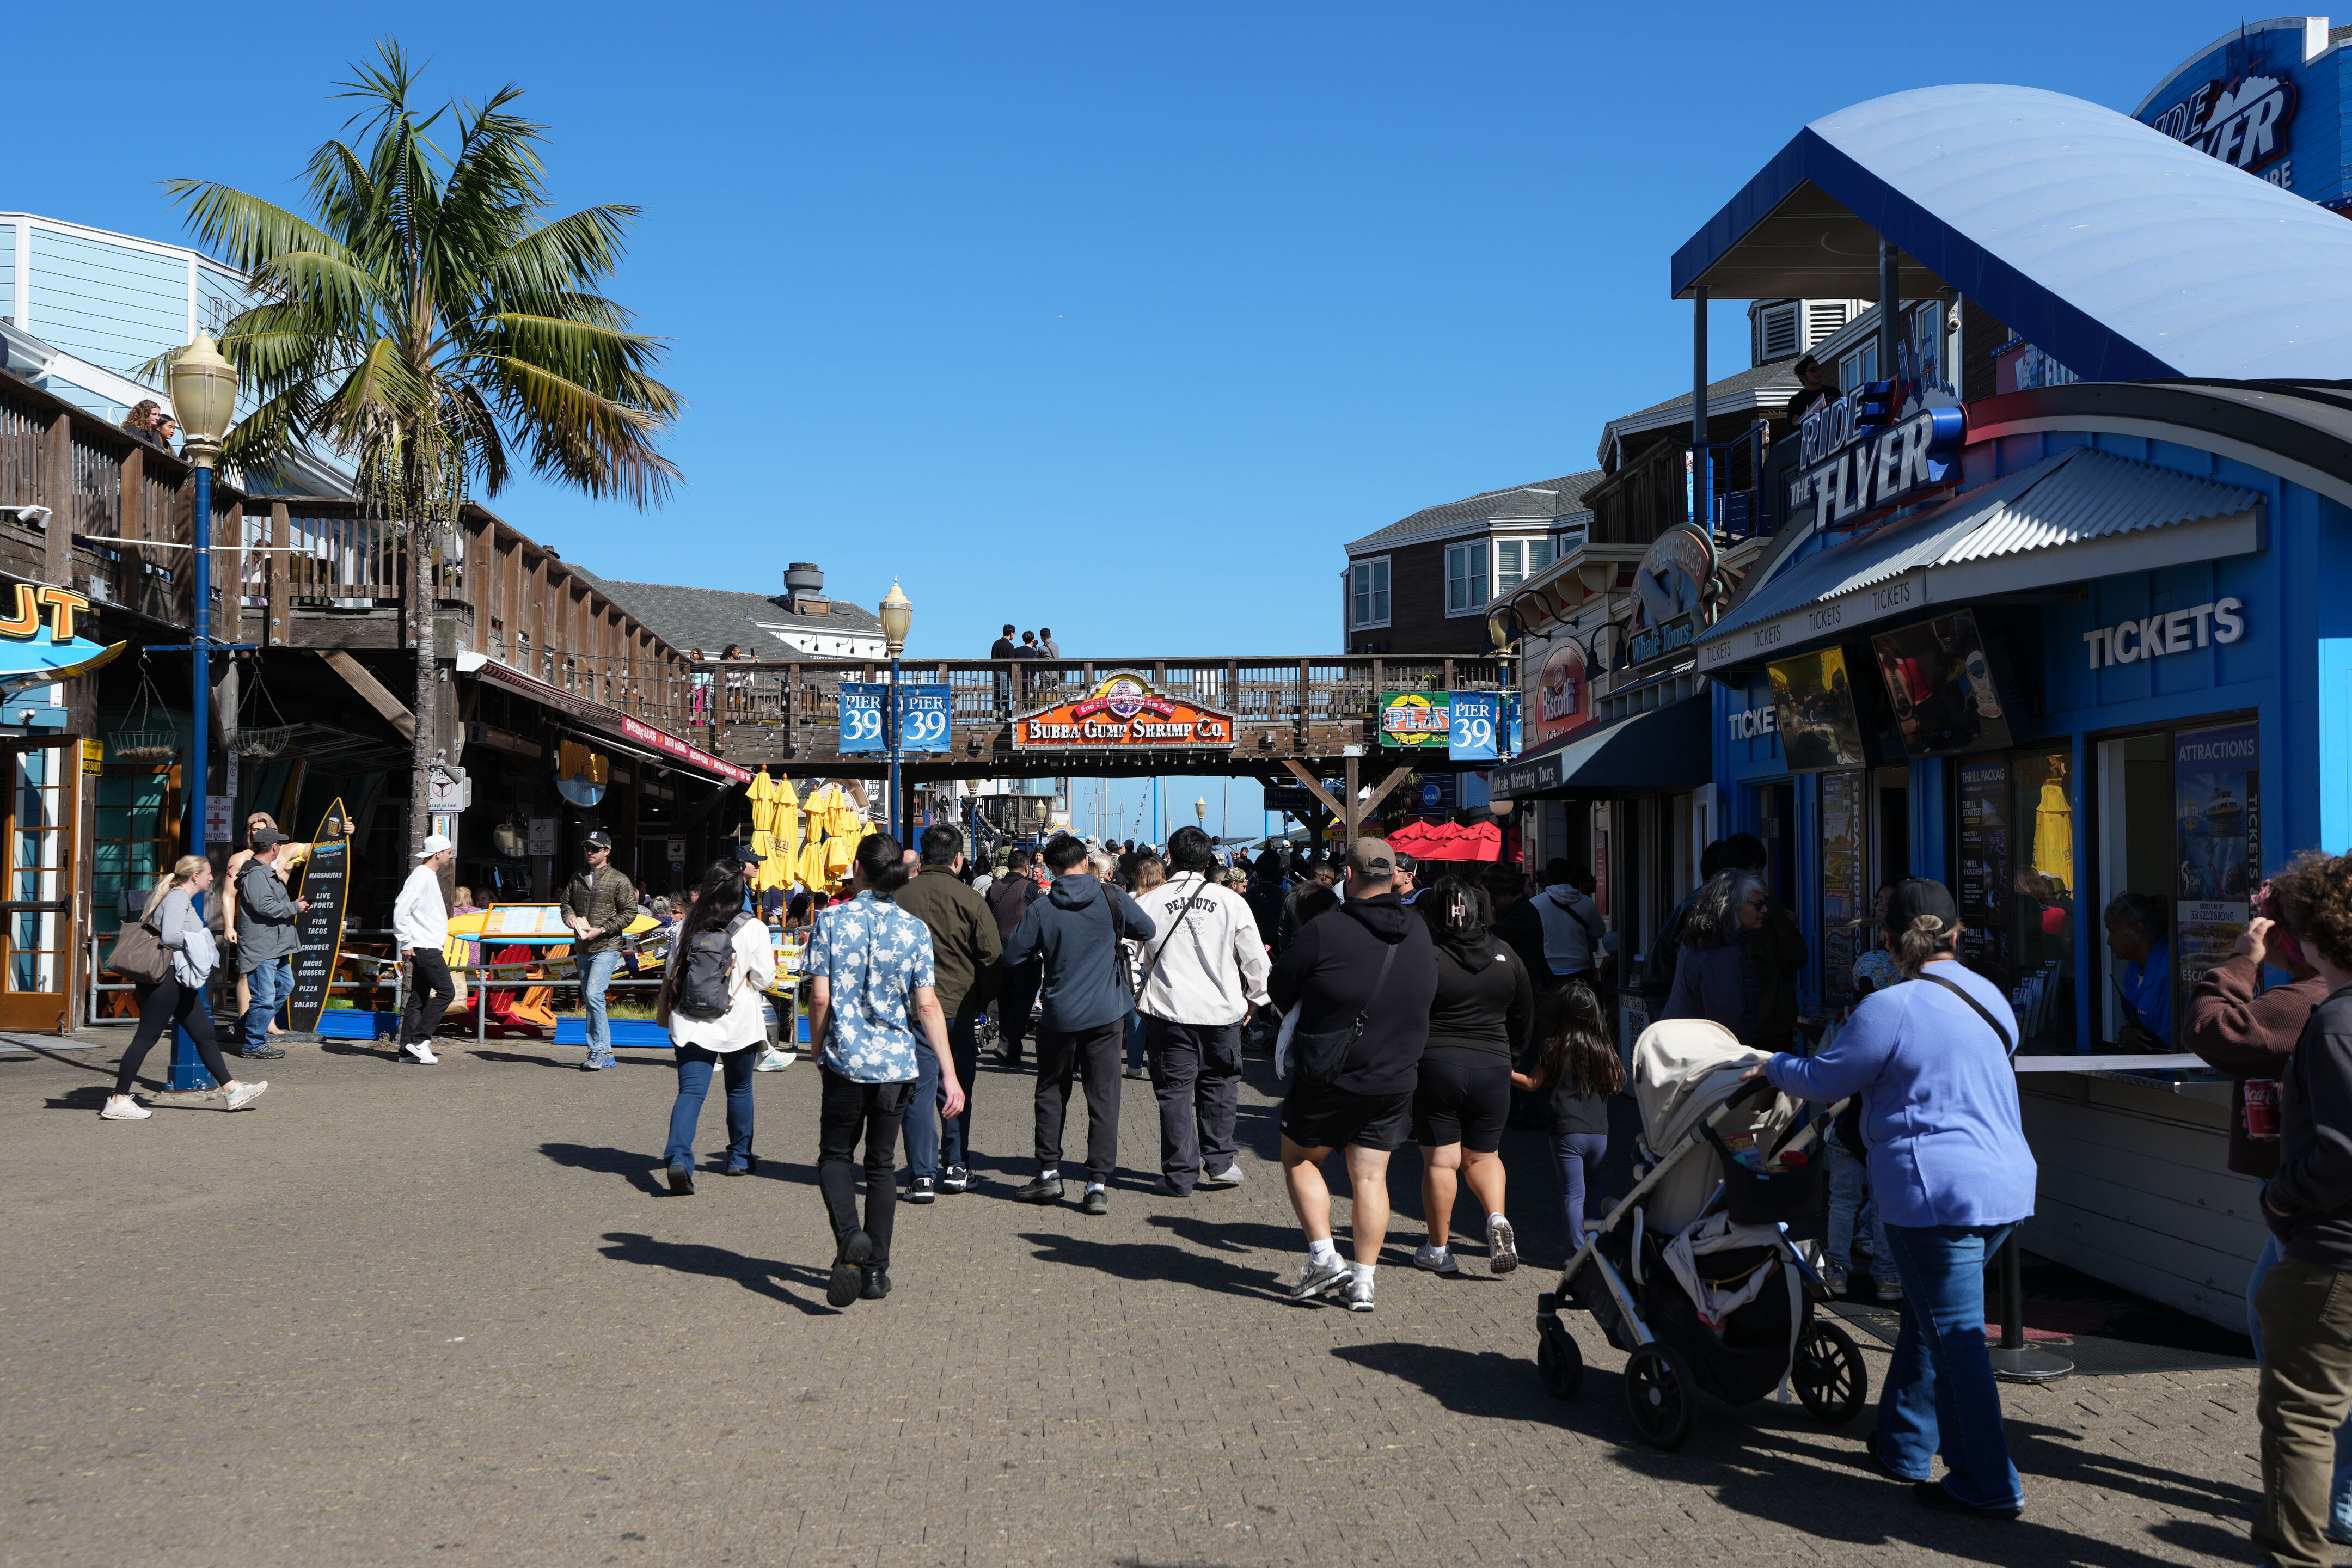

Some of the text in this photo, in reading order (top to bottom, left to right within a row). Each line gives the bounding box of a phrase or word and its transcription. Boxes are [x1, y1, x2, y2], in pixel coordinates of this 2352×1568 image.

[1799, 383, 1865, 472] RIDE
[1790, 413, 1933, 529] THE FLYER
[1650, 538, 1702, 577] FRANCISCO
[1707, 581, 1910, 663] TICKETS TICKETS TICKETS TICKETS
[2083, 597, 2244, 670] TICKETS
[1631, 624, 1699, 664] Whale Tours
[846, 696, 881, 709] PIER
[909, 697, 944, 709] PIER
[1080, 704, 1095, 713] End
[1147, 699, 1158, 708] the
[1160, 703, 1174, 713] Pier
[1455, 703, 1490, 717] PIER
[1542, 678, 1575, 721] Biscoff
[844, 710, 883, 740] 39
[906, 711, 946, 740] 39
[1454, 718, 1491, 748] 39
[2178, 739, 2255, 762] ATTRACTIONS
[1493, 767, 1554, 793] Whale Watching Tours
[1962, 768, 2005, 783] THRILL PACKAG
[2248, 794, 2258, 879] TICKETS
[1165, 897, 1217, 914] PEANUTS
[2183, 970, 2205, 981] ESCA
[1621, 996, 1630, 1008] Book
[1630, 997, 1641, 1011] Tickets
[1668, 1144, 1686, 1160] VISTA
